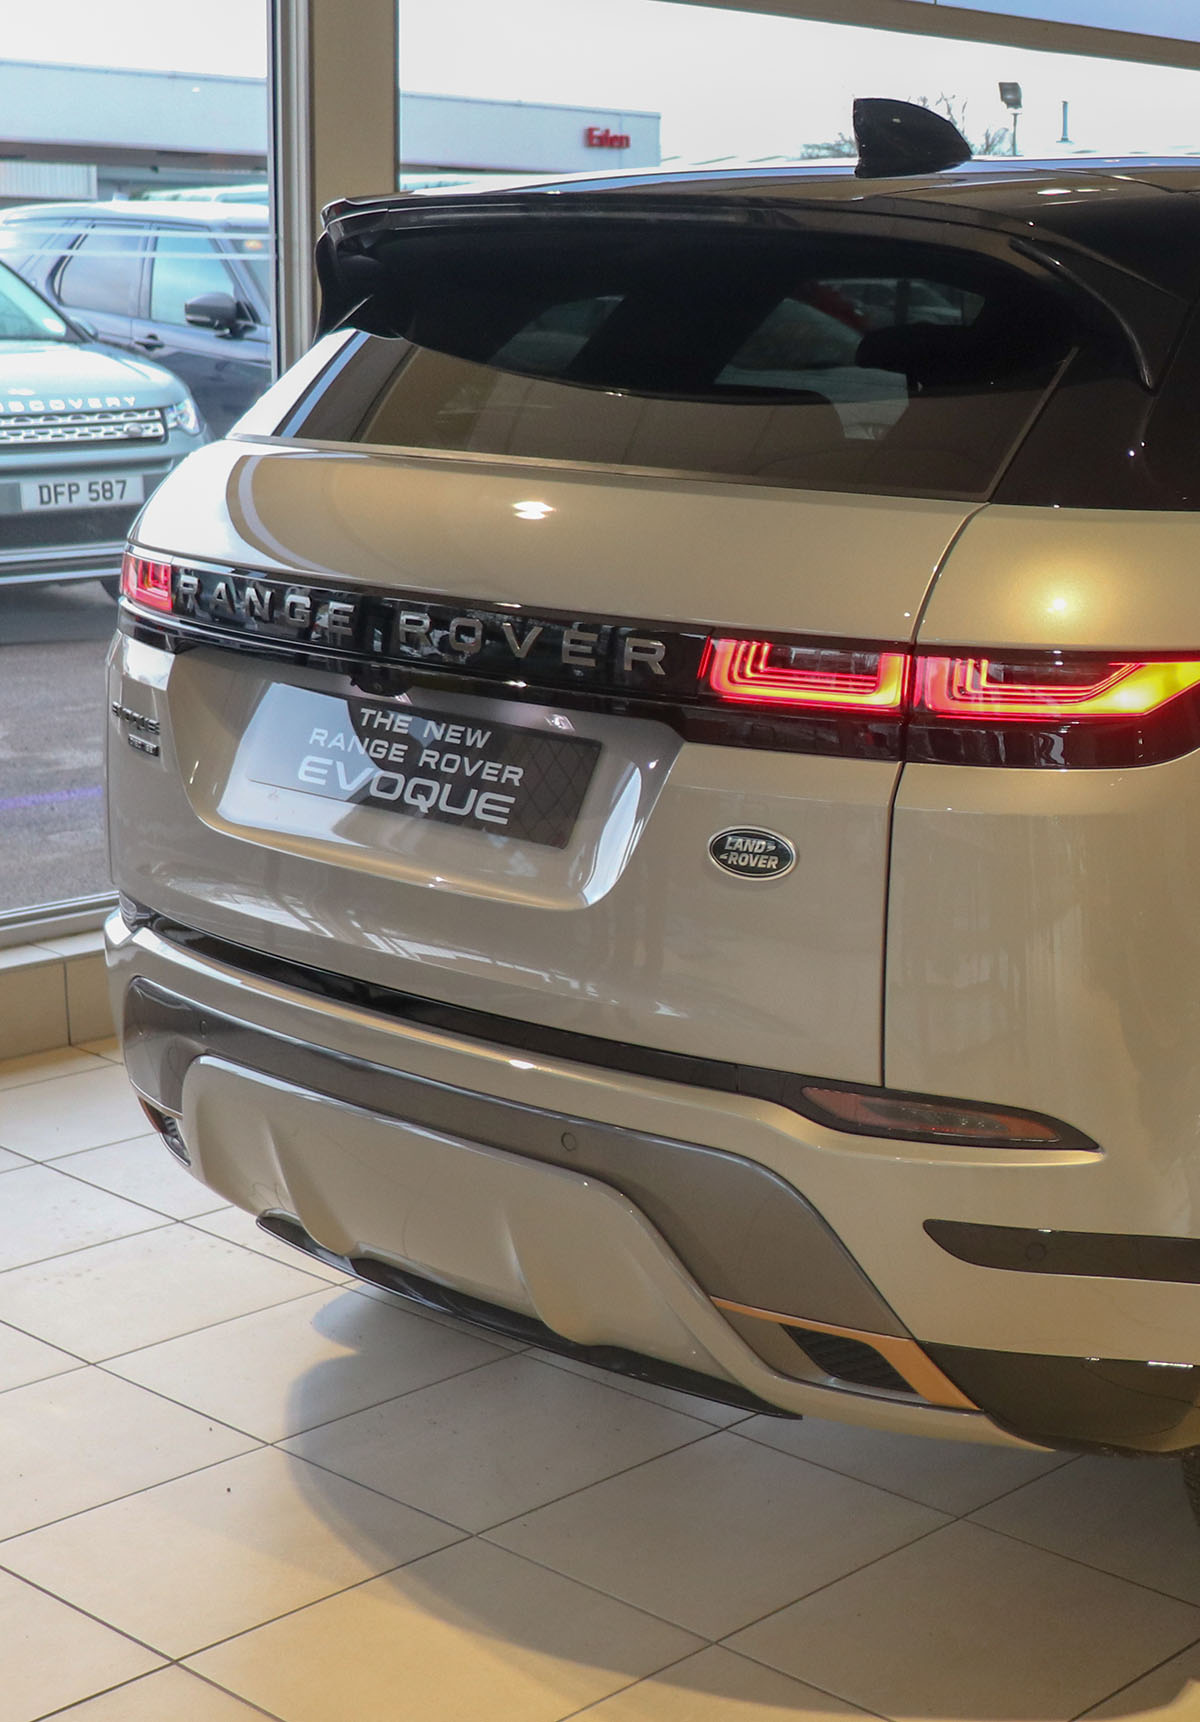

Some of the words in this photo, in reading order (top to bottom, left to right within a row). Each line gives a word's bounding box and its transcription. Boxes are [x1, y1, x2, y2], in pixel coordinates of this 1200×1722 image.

[38, 481, 80, 505] DFP
[88, 479, 127, 502] 587
[177, 573, 355, 636] RANGE
[399, 610, 666, 676] ROVER
[359, 707, 413, 735] THE
[423, 720, 491, 749] NEW
[308, 728, 409, 764] RANGE
[418, 749, 525, 787] ROVER
[297, 755, 517, 825] EVOQUE
[724, 836, 766, 854] LAND
[727, 852, 779, 870] ROVER
